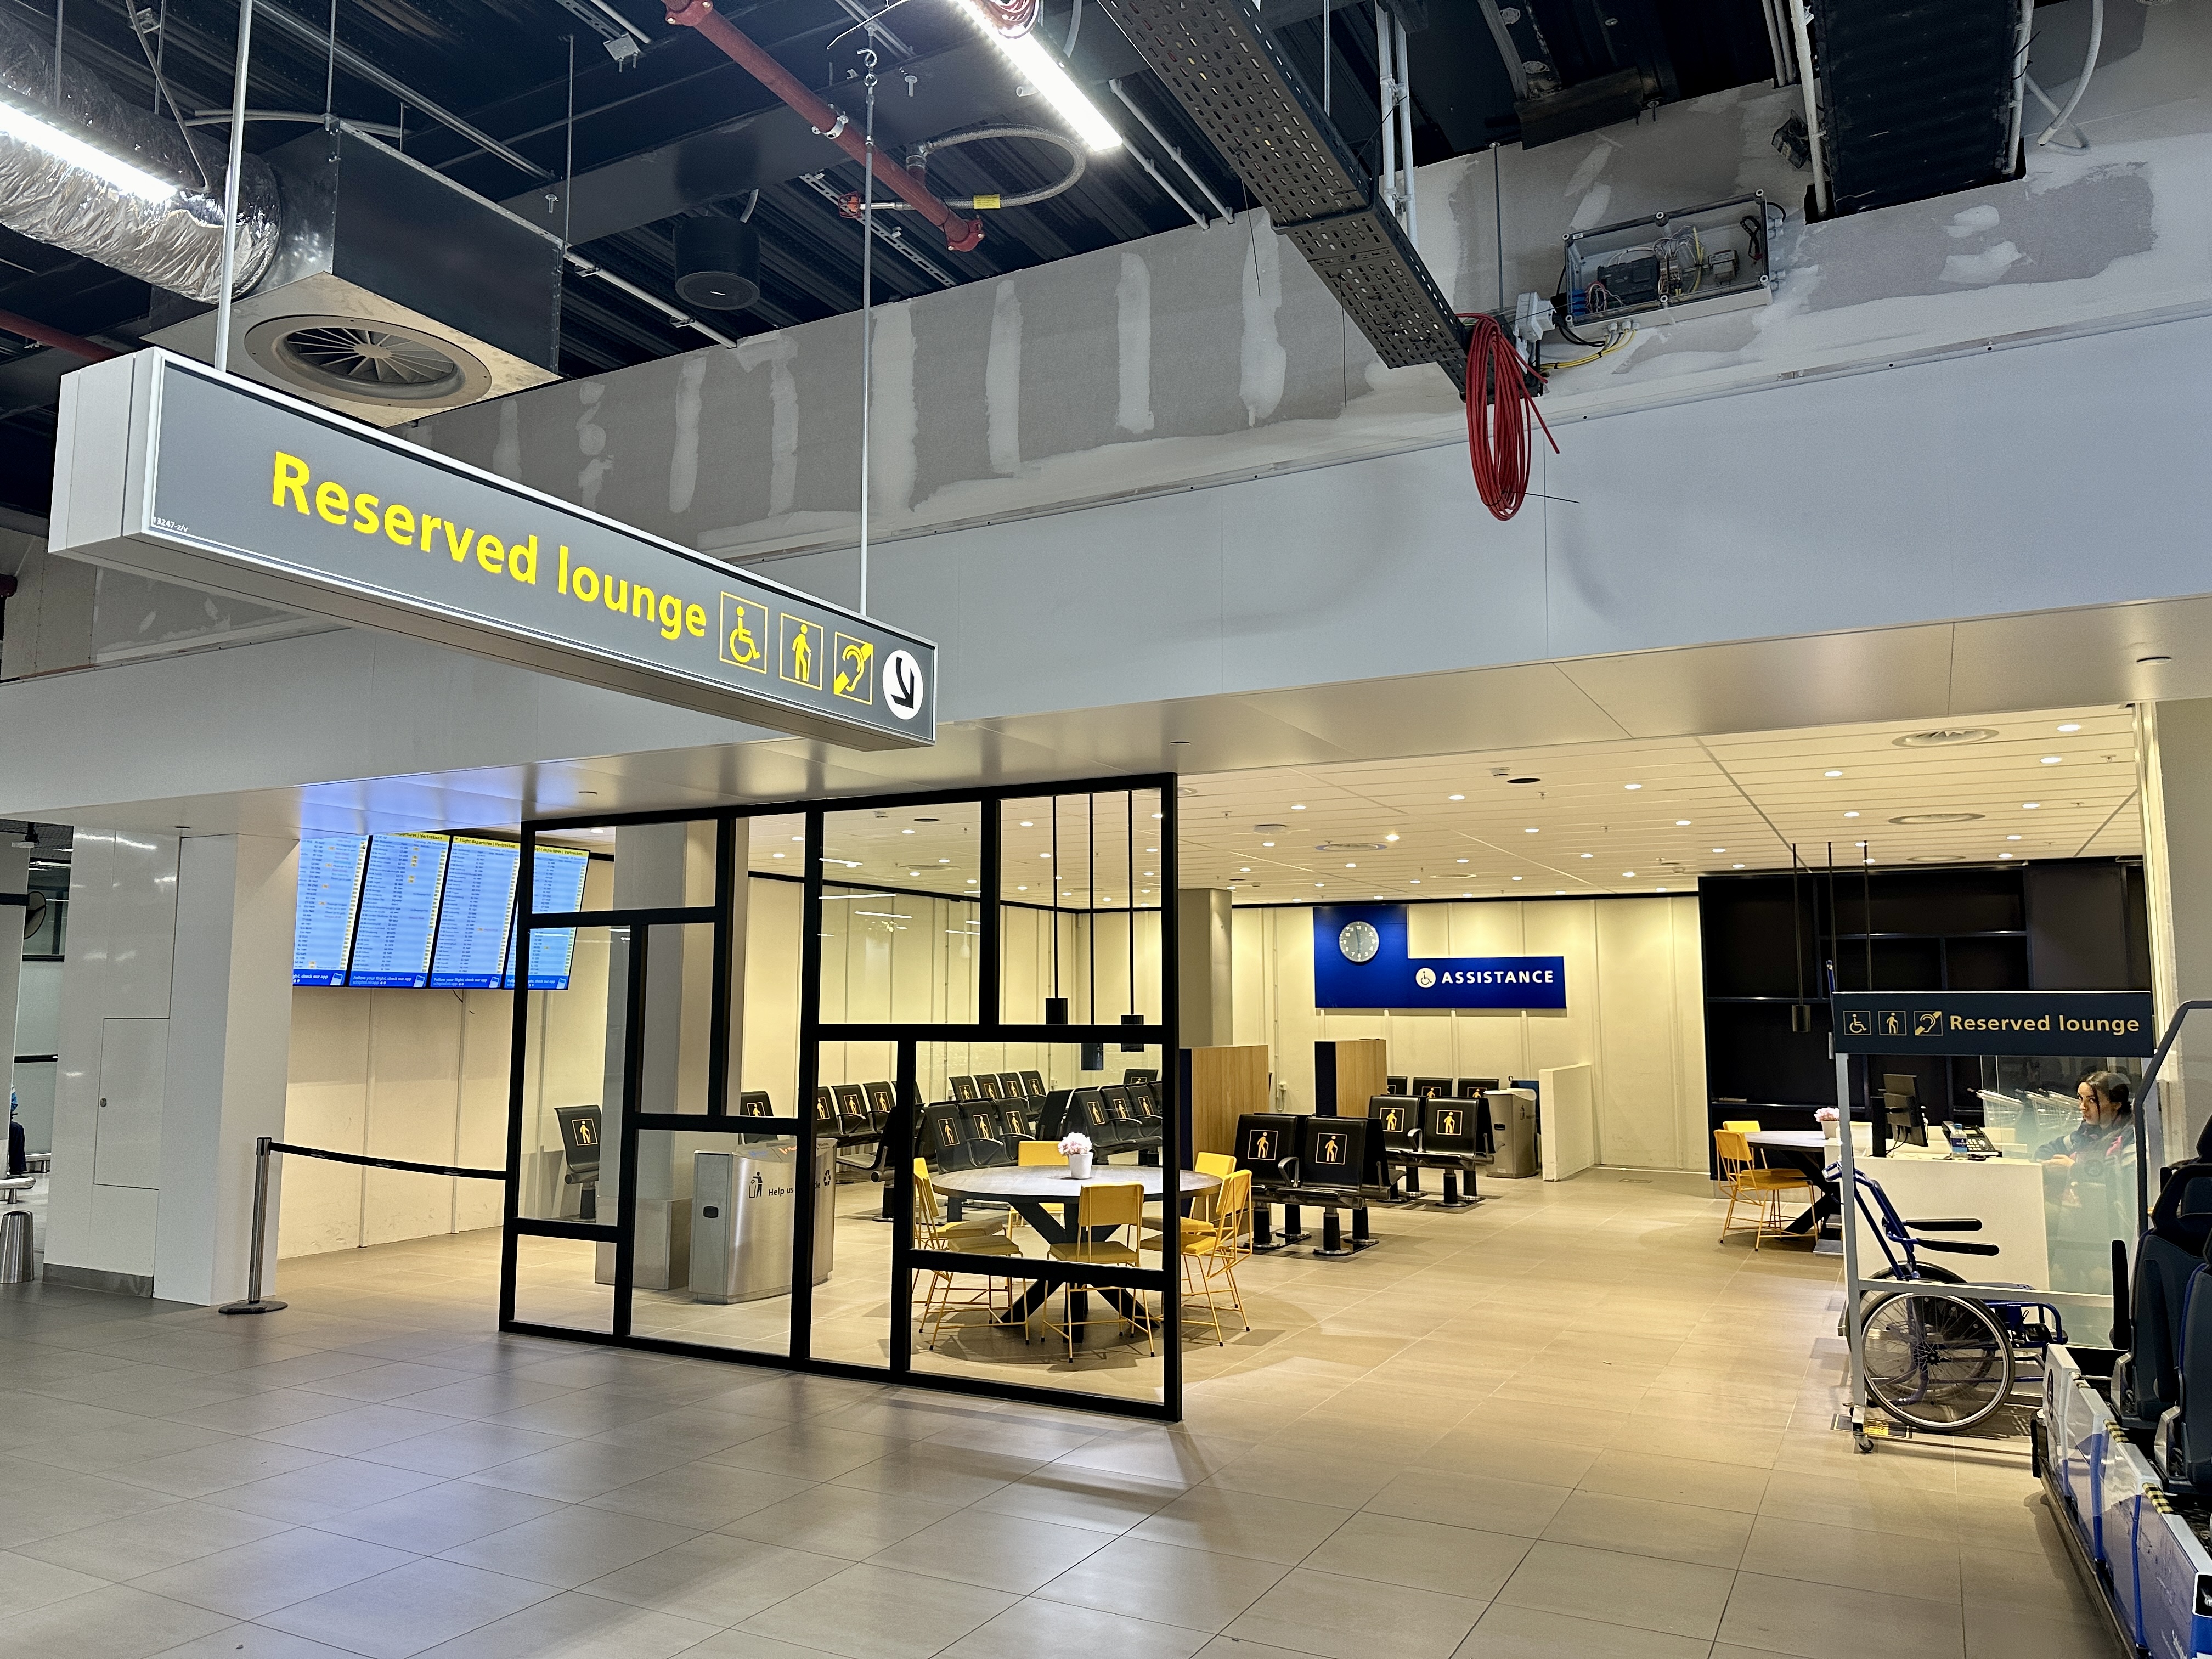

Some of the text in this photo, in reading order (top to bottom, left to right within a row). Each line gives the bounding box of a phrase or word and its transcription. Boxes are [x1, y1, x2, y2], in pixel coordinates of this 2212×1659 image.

[272, 451, 707, 641] Reserved lounge
[1441, 970, 1554, 984] ASSISTANCE
[1950, 1014, 2139, 1036] Reserved lounge
[768, 1187, 785, 1197] Help
